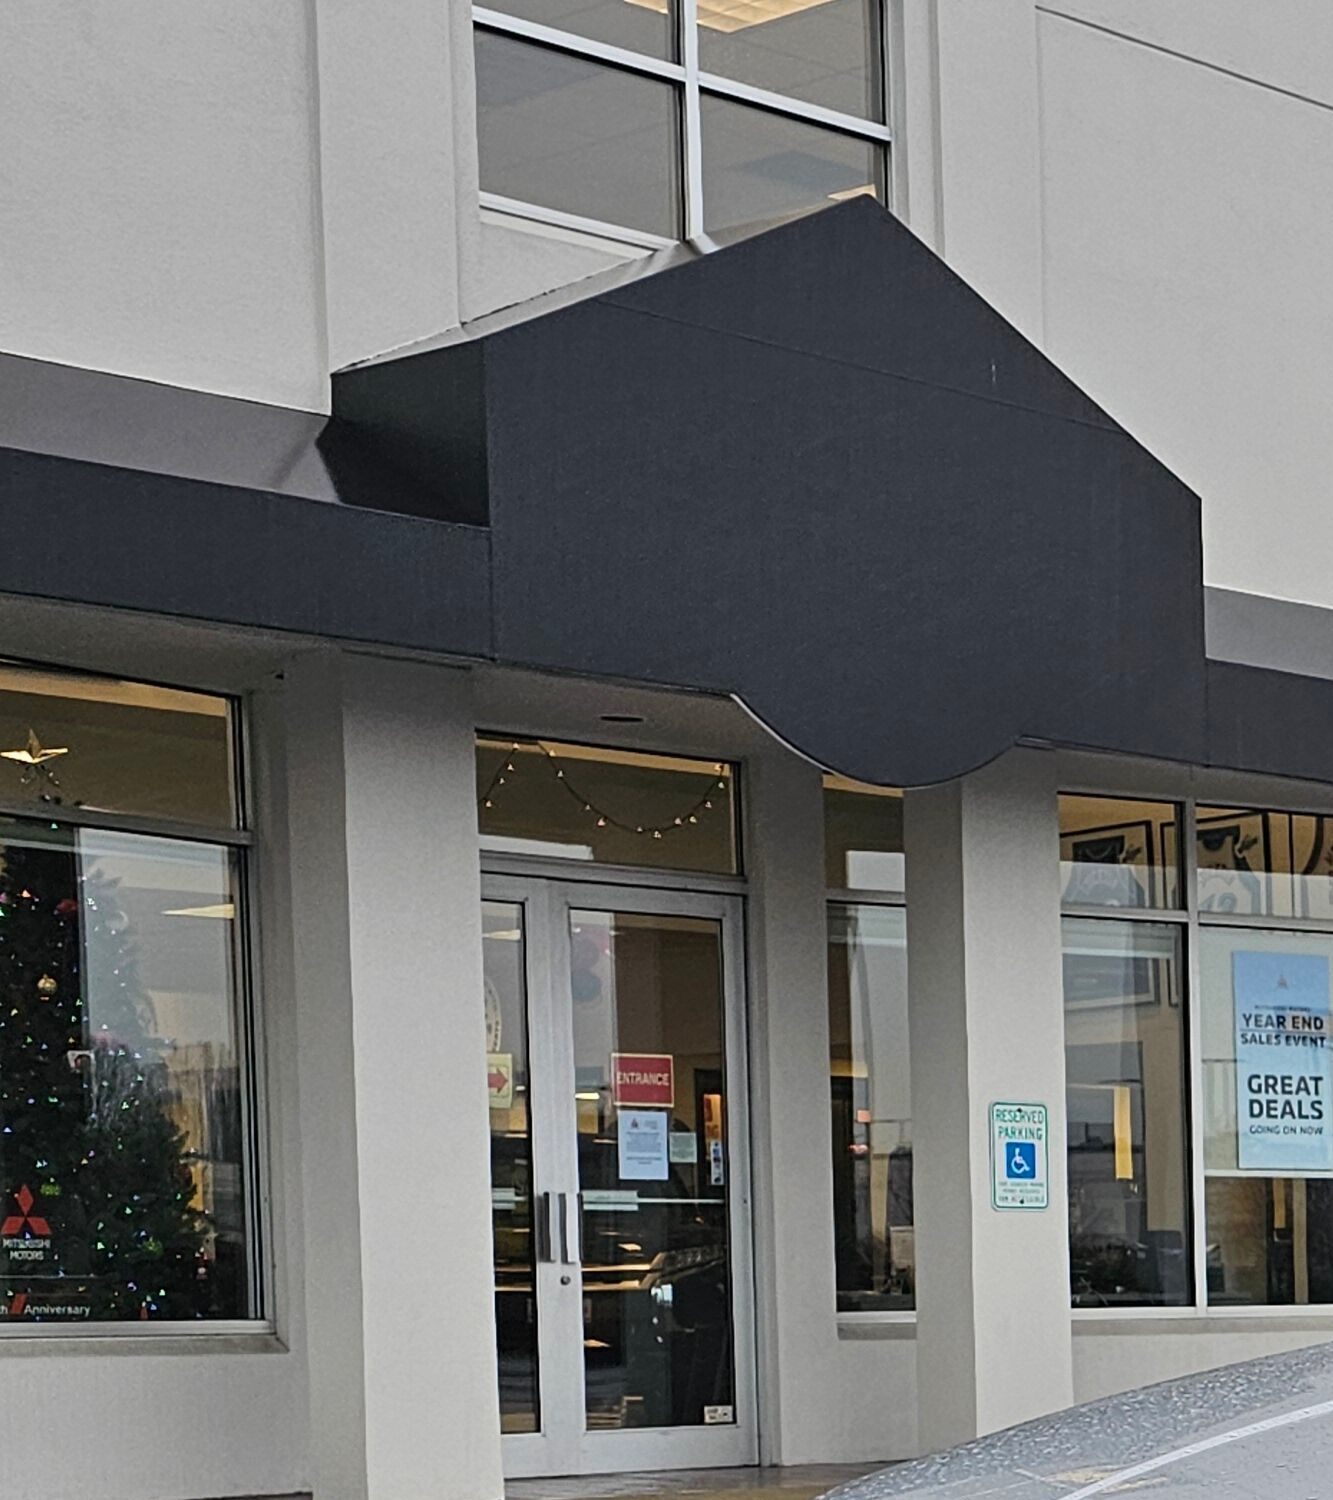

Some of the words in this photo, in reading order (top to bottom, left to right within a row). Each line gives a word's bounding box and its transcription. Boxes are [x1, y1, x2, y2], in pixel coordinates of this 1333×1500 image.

[1242, 1013, 1287, 1030] YEAR
[1291, 1015, 1324, 1031] END
[1240, 1033, 1281, 1046] SALES
[1285, 1034, 1327, 1049] EVENT
[616, 1071, 670, 1087] ENTRANCE
[1247, 1073, 1323, 1097] GREAT
[996, 1108, 1044, 1125] RESERVED
[1249, 1098, 1324, 1121] DEALS
[998, 1125, 1043, 1141] PARKING
[1250, 1124, 1281, 1136] GOING
[1283, 1125, 1297, 1136] ON
[1300, 1126, 1324, 1136] NOW
[24, 1304, 91, 1317] Anniversary
